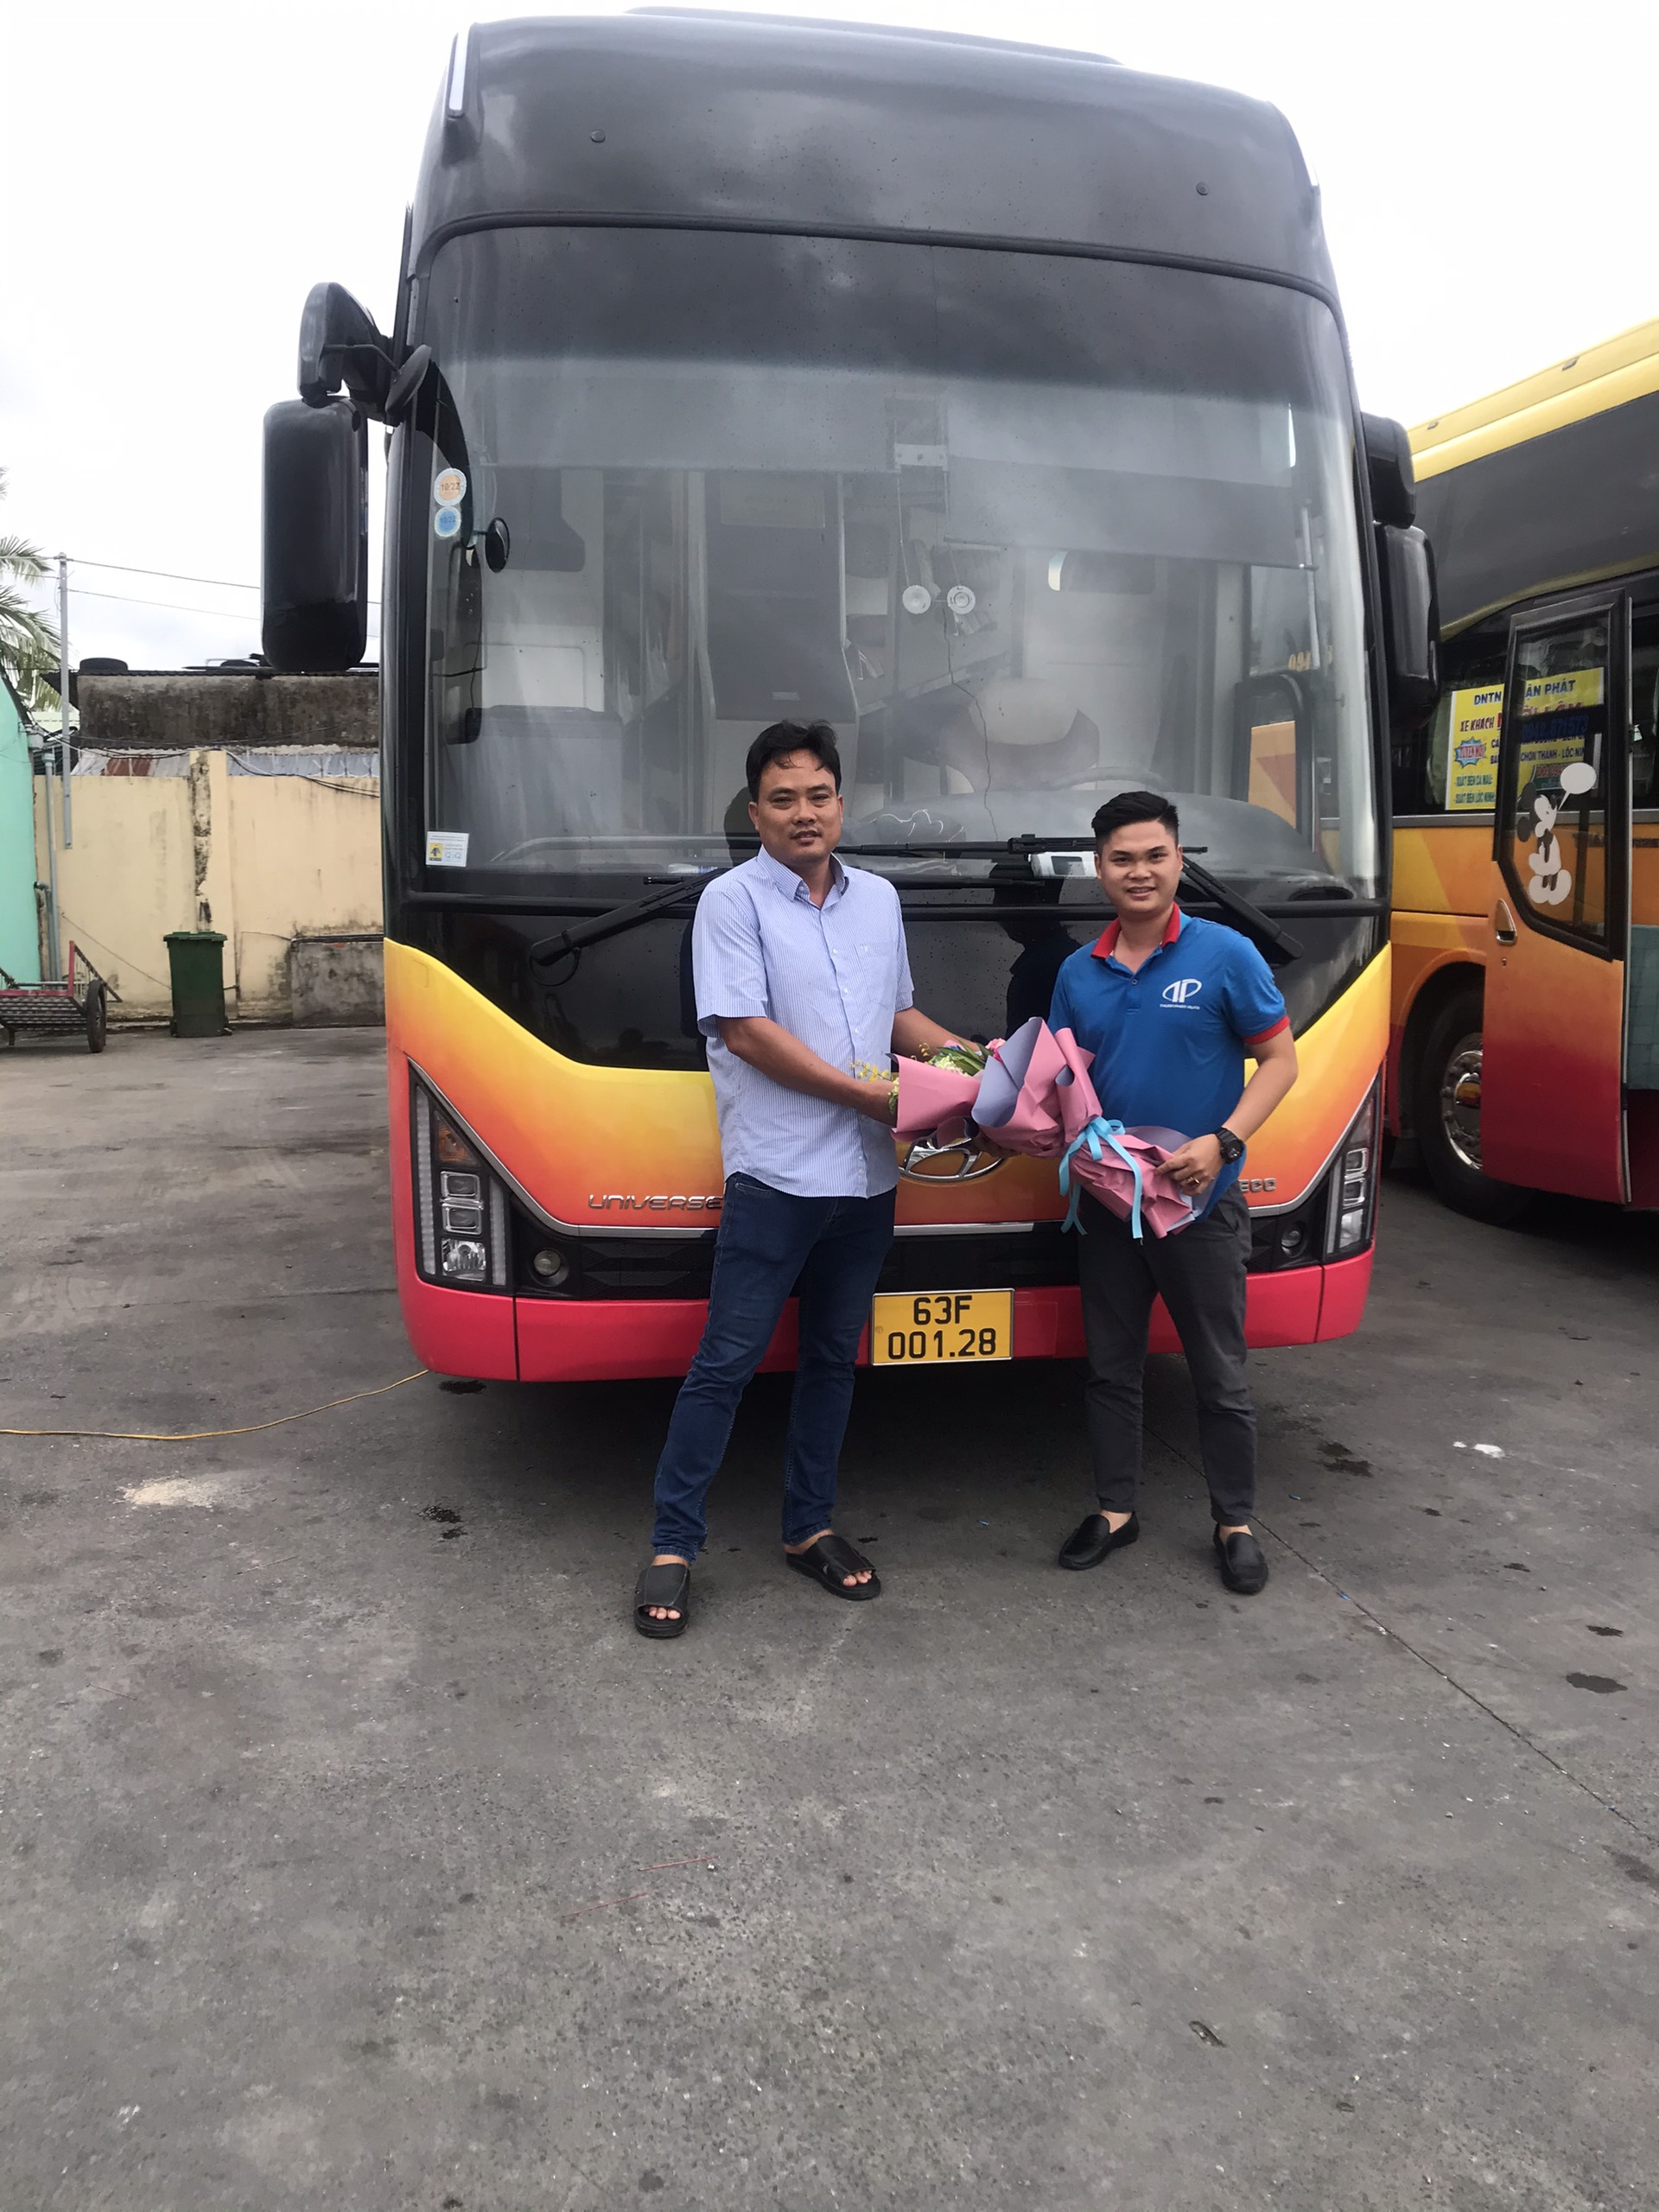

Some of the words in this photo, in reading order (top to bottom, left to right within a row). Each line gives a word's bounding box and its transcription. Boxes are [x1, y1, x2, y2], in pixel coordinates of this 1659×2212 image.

[442, 482, 460, 491] 10/22
[1474, 691, 1502, 705] DNTN
[1544, 678, 1576, 695] PHÁT
[1459, 720, 1470, 732] XE
[588, 1194, 724, 1210] UNIVERSE
[913, 1295, 973, 1325] 63F
[888, 1328, 996, 1360] 001.28
